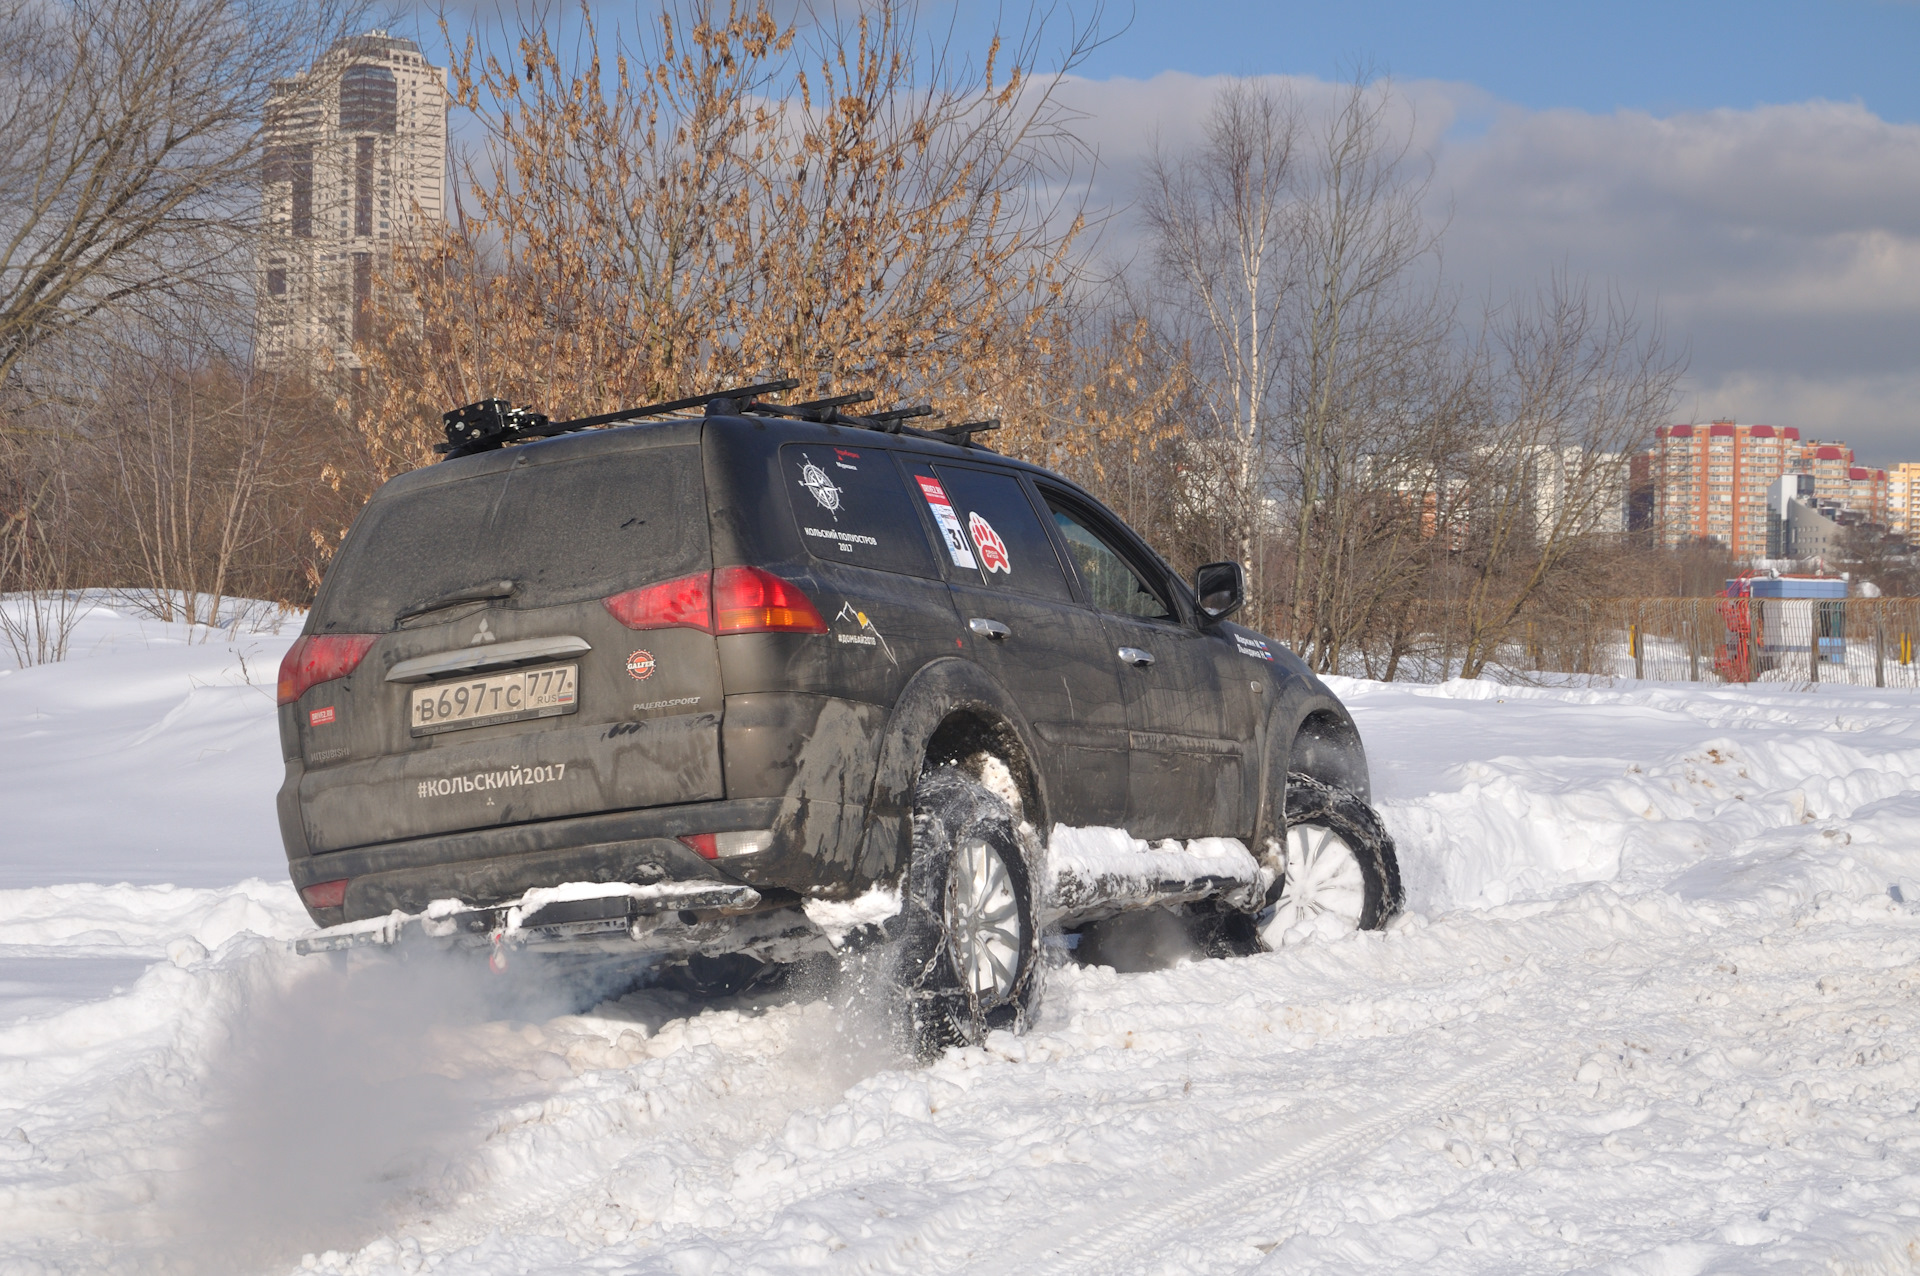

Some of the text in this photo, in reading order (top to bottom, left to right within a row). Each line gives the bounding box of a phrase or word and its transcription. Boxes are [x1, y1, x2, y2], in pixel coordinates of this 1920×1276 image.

[804, 527, 877, 545] КОЛЬСКИЙ ПОЛУОСТРОВ
[947, 528, 969, 551] 31
[838, 543, 853, 552] 2017
[627, 660, 655, 670] GALFER
[528, 669, 568, 697] 777
[537, 695, 558, 705] RUS
[310, 748, 350, 761] MITSUBISHI
[417, 764, 565, 798] #КОЛЬСКИЙ2017
